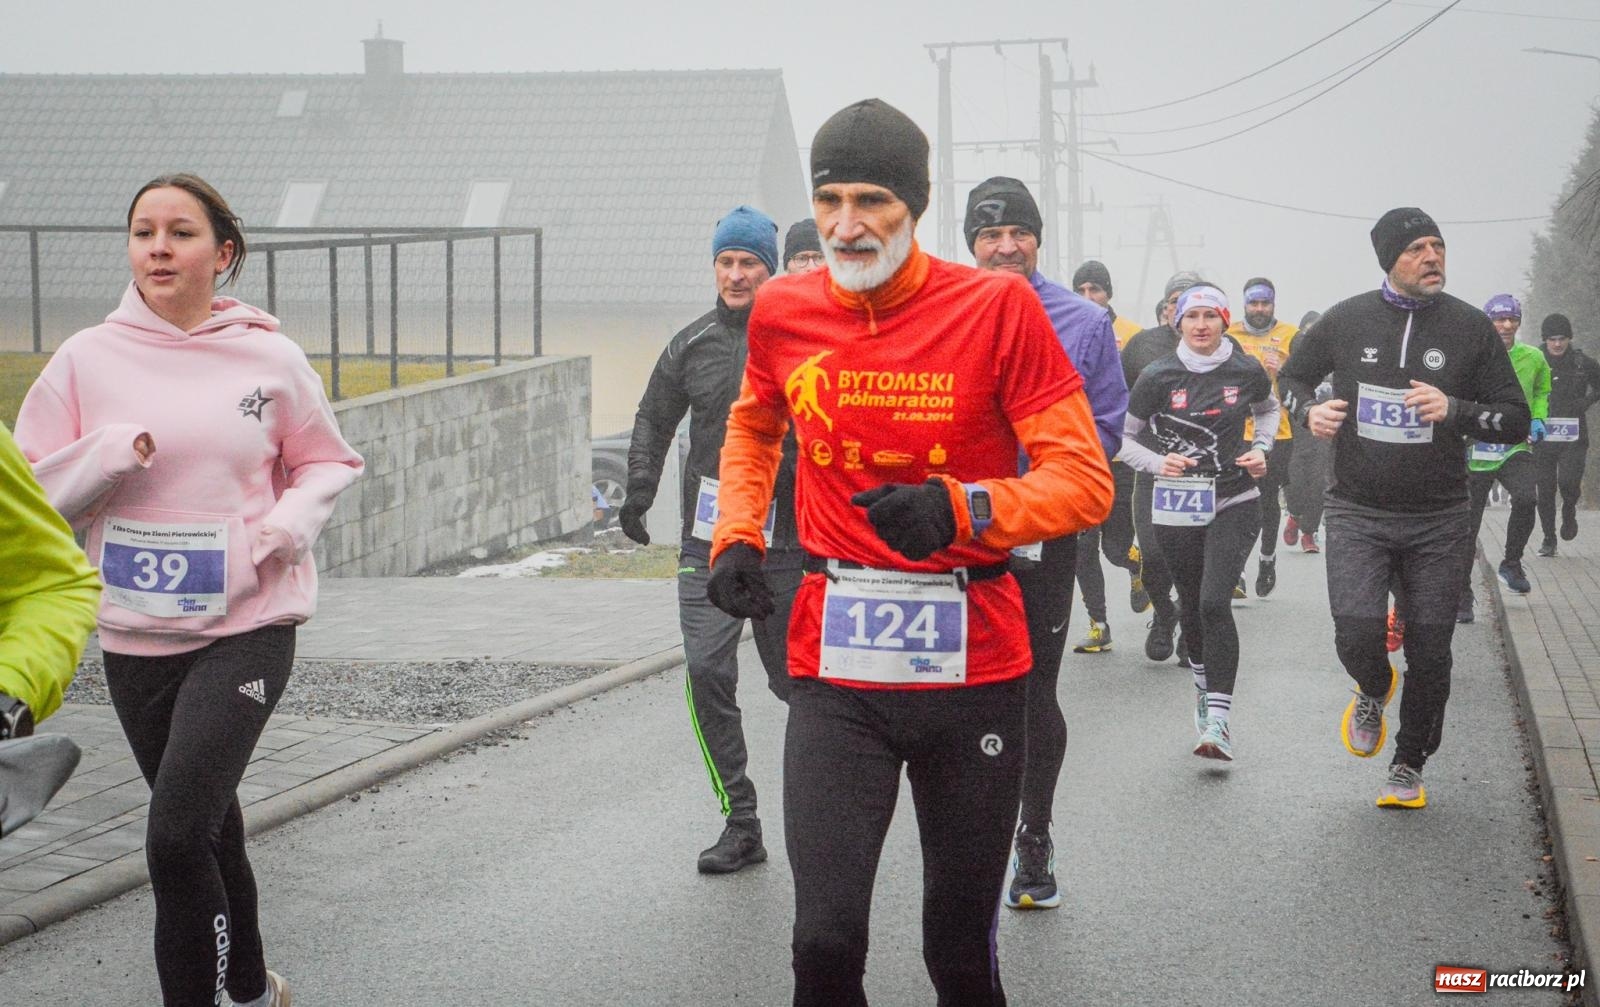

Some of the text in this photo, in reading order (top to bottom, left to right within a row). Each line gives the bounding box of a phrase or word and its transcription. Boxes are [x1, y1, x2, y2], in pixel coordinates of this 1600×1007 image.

[838, 370, 954, 392] BYTOMSKI
[1371, 402, 1419, 427] 131
[1552, 425, 1568, 435] 26
[1162, 490, 1203, 512] 174
[126, 527, 142, 536] Cross
[172, 530, 217, 539] Pietrowickiej
[133, 551, 189, 590] 39
[847, 601, 940, 648] 124
[238, 685, 267, 705] adidas
